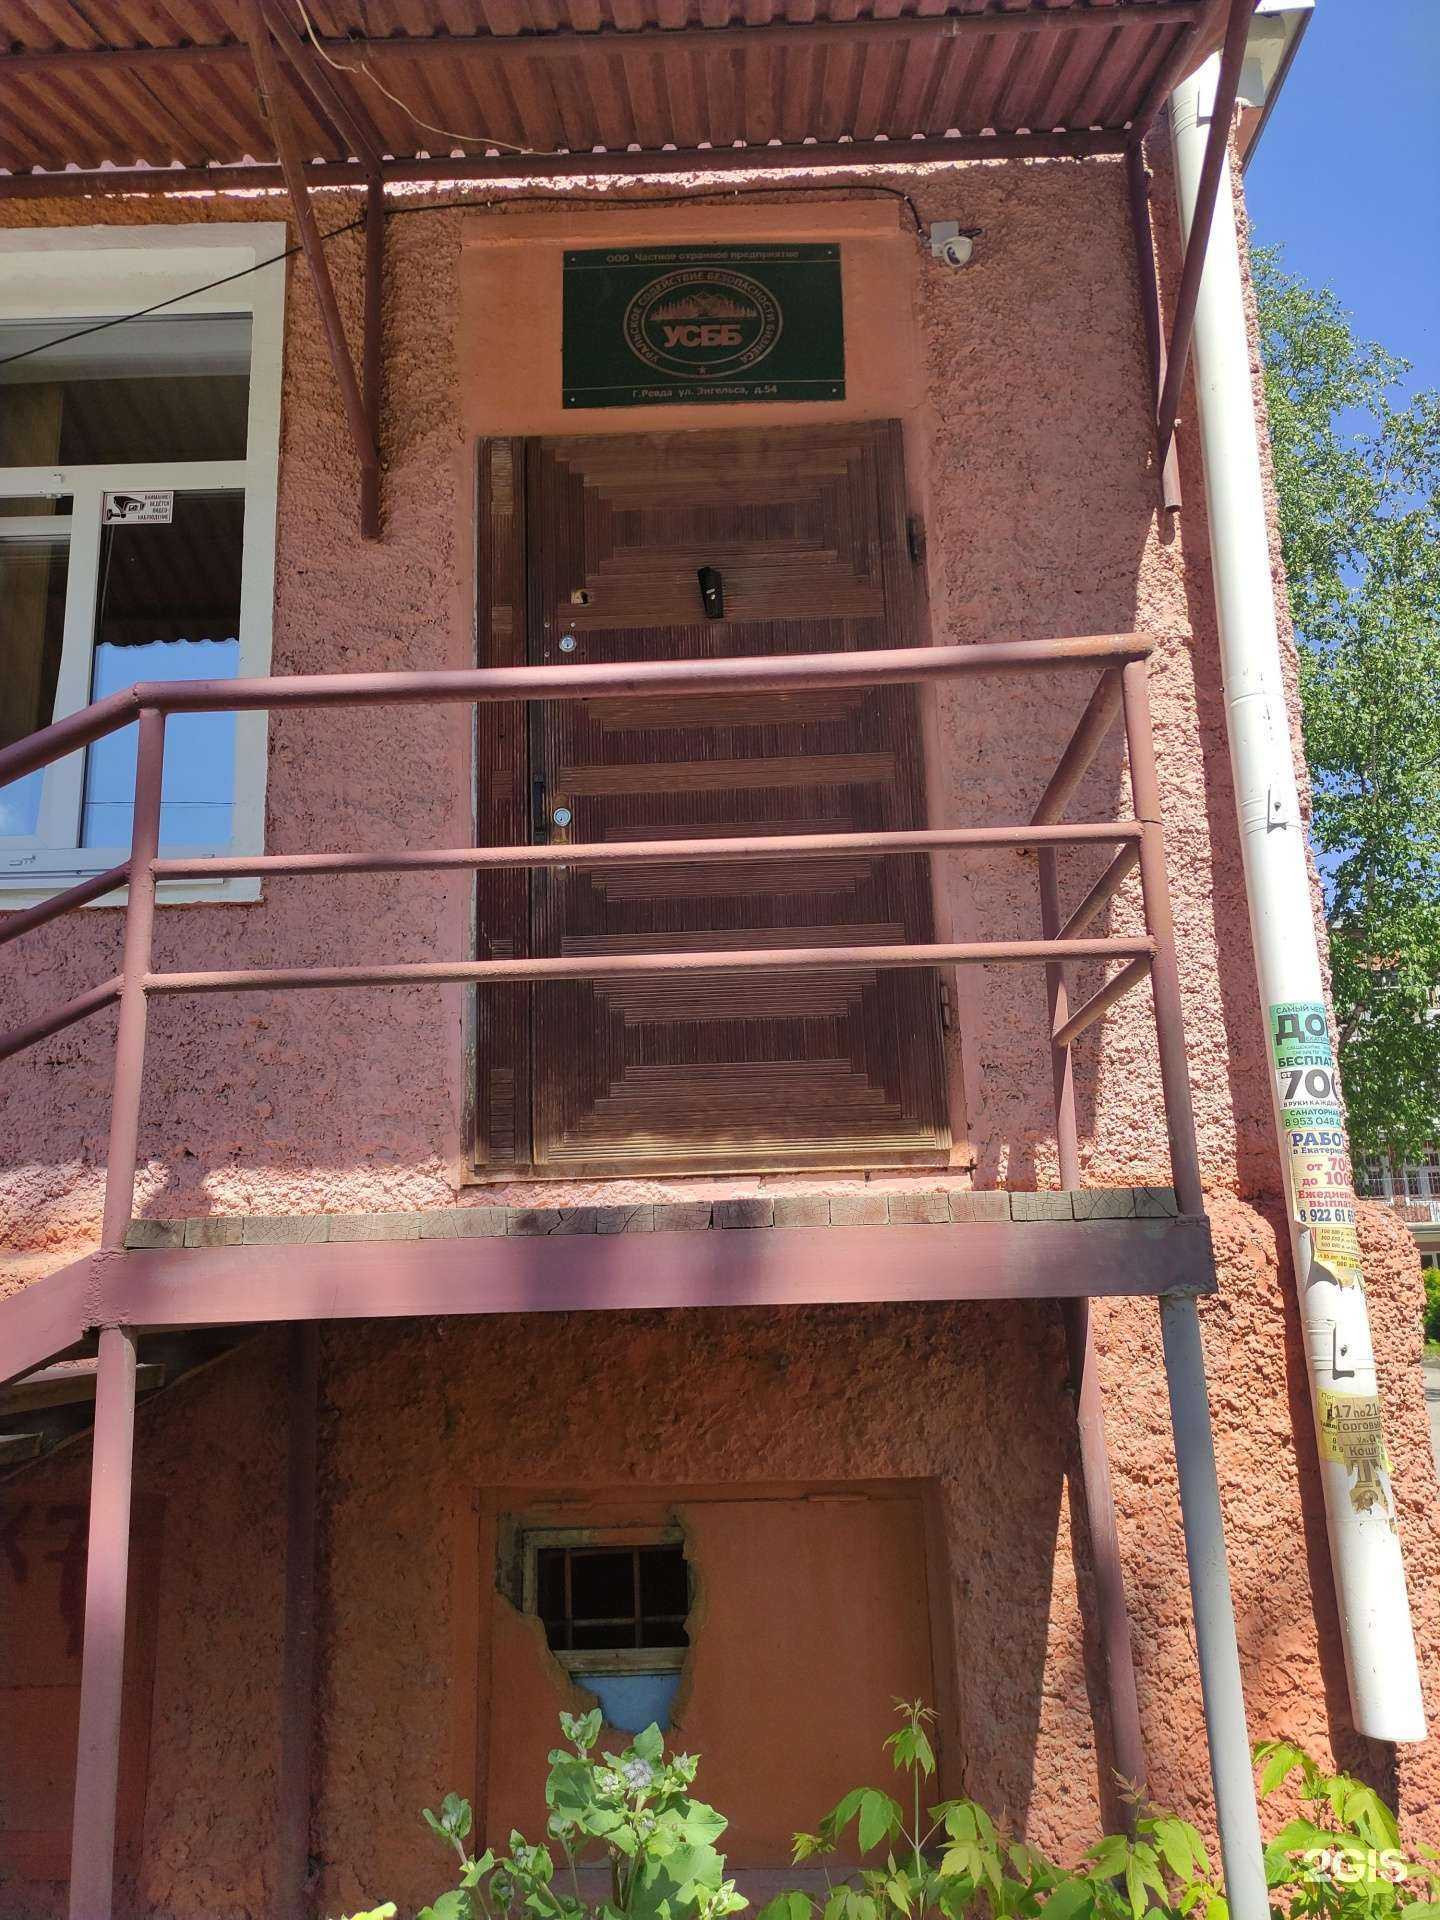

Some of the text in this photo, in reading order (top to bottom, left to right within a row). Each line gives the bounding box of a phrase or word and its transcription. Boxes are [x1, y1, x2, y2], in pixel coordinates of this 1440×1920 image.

[606, 254, 630, 264] ООО
[663, 324, 744, 348] УСББ
[1275, 1013, 1329, 1046] ДО
[1292, 1117, 1314, 1126] 953
[1291, 1132, 1344, 1147] РАБО
[1328, 1157, 1348, 1171] 70
[1309, 1208, 1332, 1222] 922
